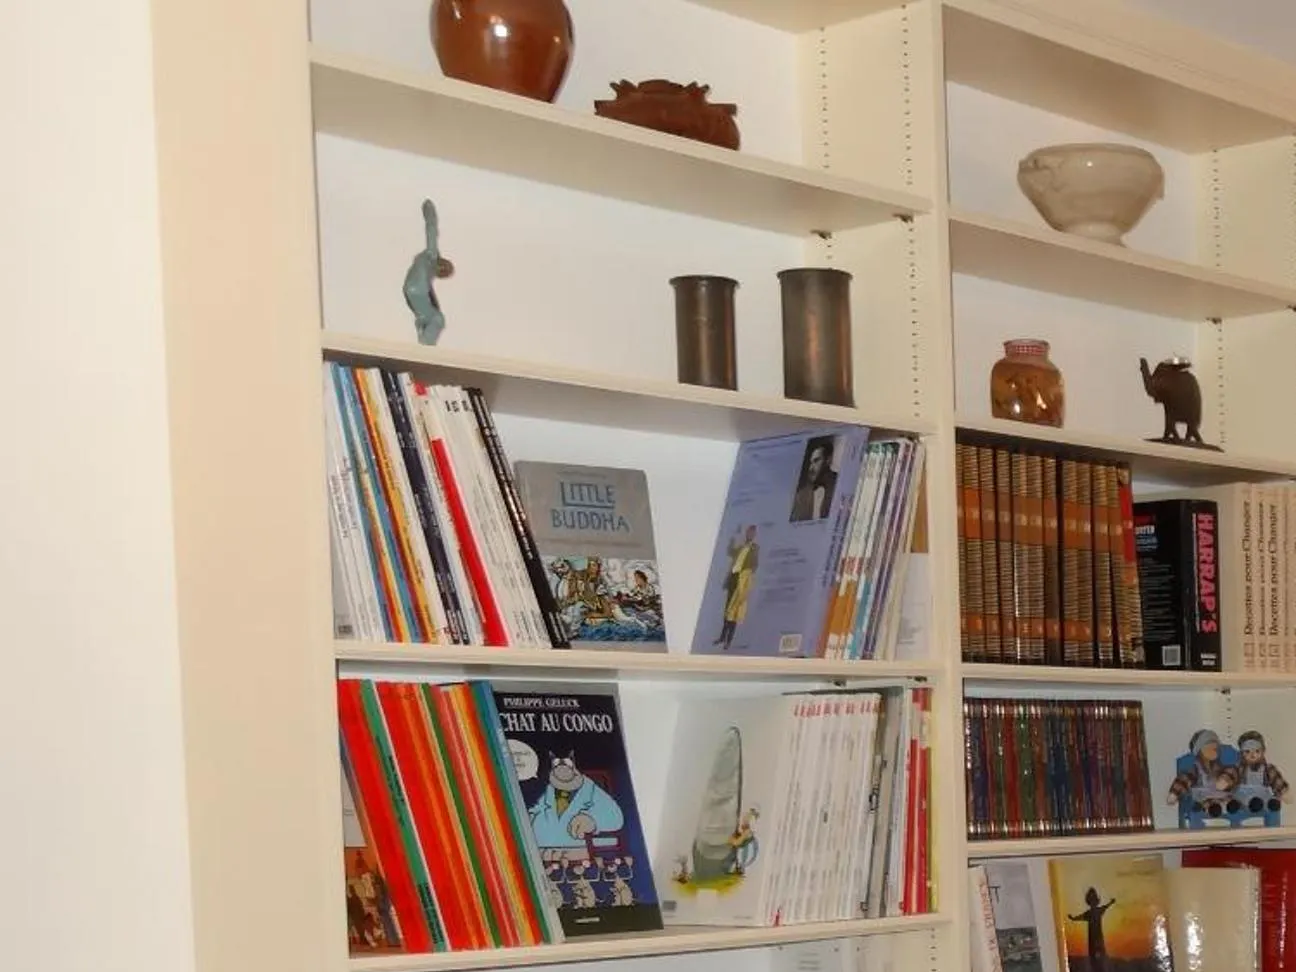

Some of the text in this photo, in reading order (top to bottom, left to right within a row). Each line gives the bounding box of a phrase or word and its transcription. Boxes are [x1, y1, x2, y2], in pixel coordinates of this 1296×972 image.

[559, 481, 616, 509] LITTLE
[551, 508, 630, 533] BUDDHA
[1196, 513, 1217, 633] HARRAP'S
[541, 713, 561, 732] AU
[563, 714, 613, 733] CONGO
